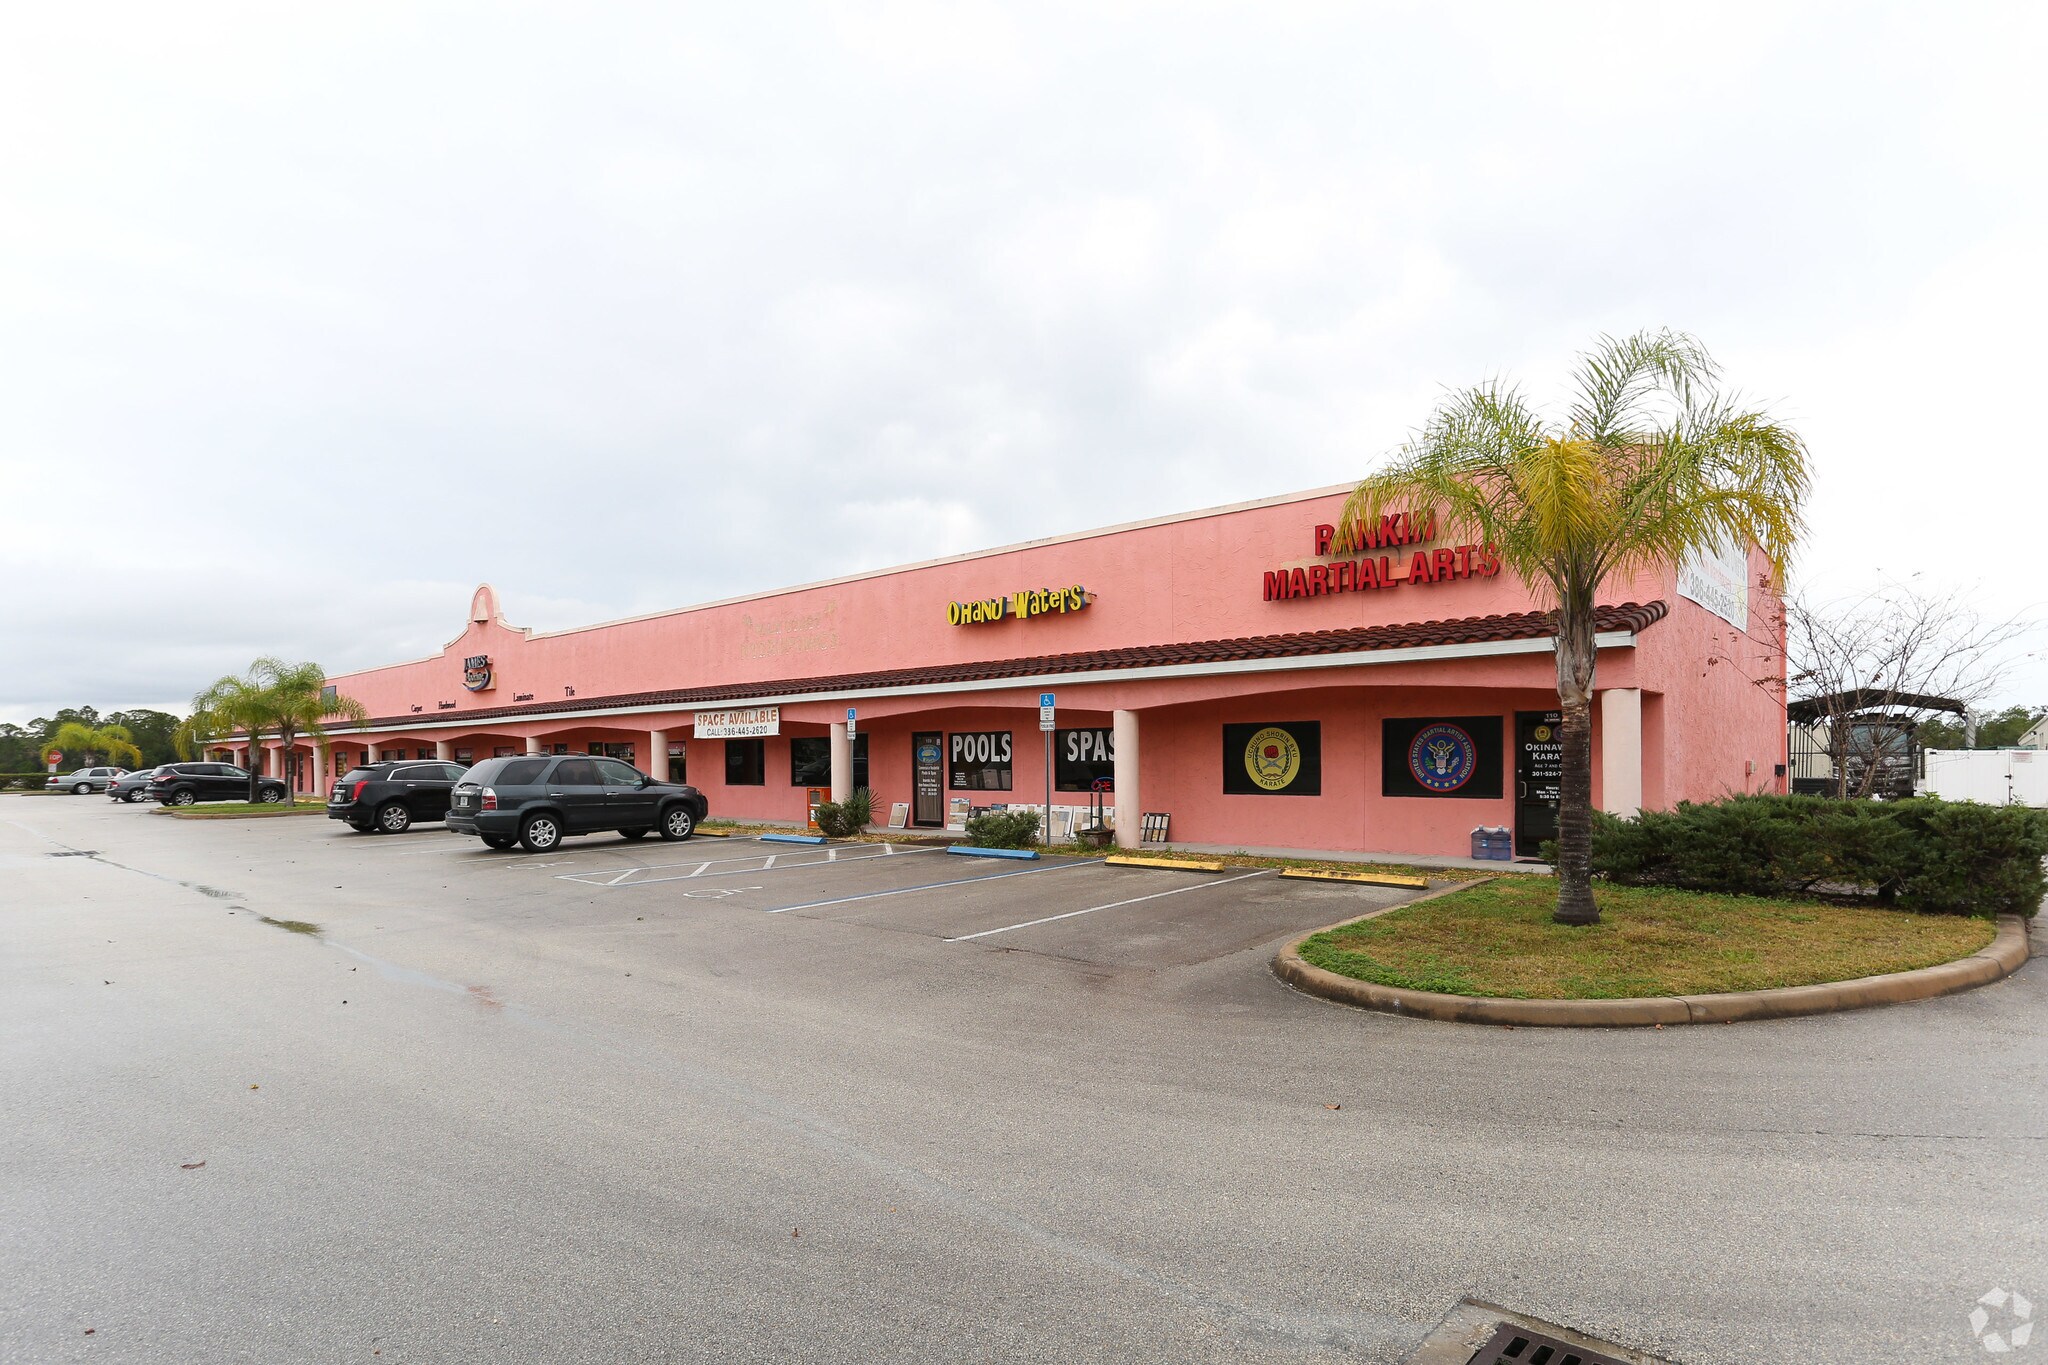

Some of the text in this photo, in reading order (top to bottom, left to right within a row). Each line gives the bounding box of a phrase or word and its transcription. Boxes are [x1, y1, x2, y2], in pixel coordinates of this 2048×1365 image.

[1263, 541, 1500, 601] MARTIAL ARTS
[513, 692, 534, 702] Laminate
[564, 686, 575, 697] Tile
[411, 704, 423, 713] Carpet
[697, 709, 777, 727] SPACE AVAILABLE
[706, 728, 723, 737] CALL:
[952, 733, 1012, 763] POOLS
[1289, 743, 1299, 758] RYU
[1412, 727, 1473, 779] UNITED STATES MARTIAL ARTIST ASSOCIATION
[1532, 752, 1562, 760] KARA
[1259, 779, 1286, 787] KARATE
